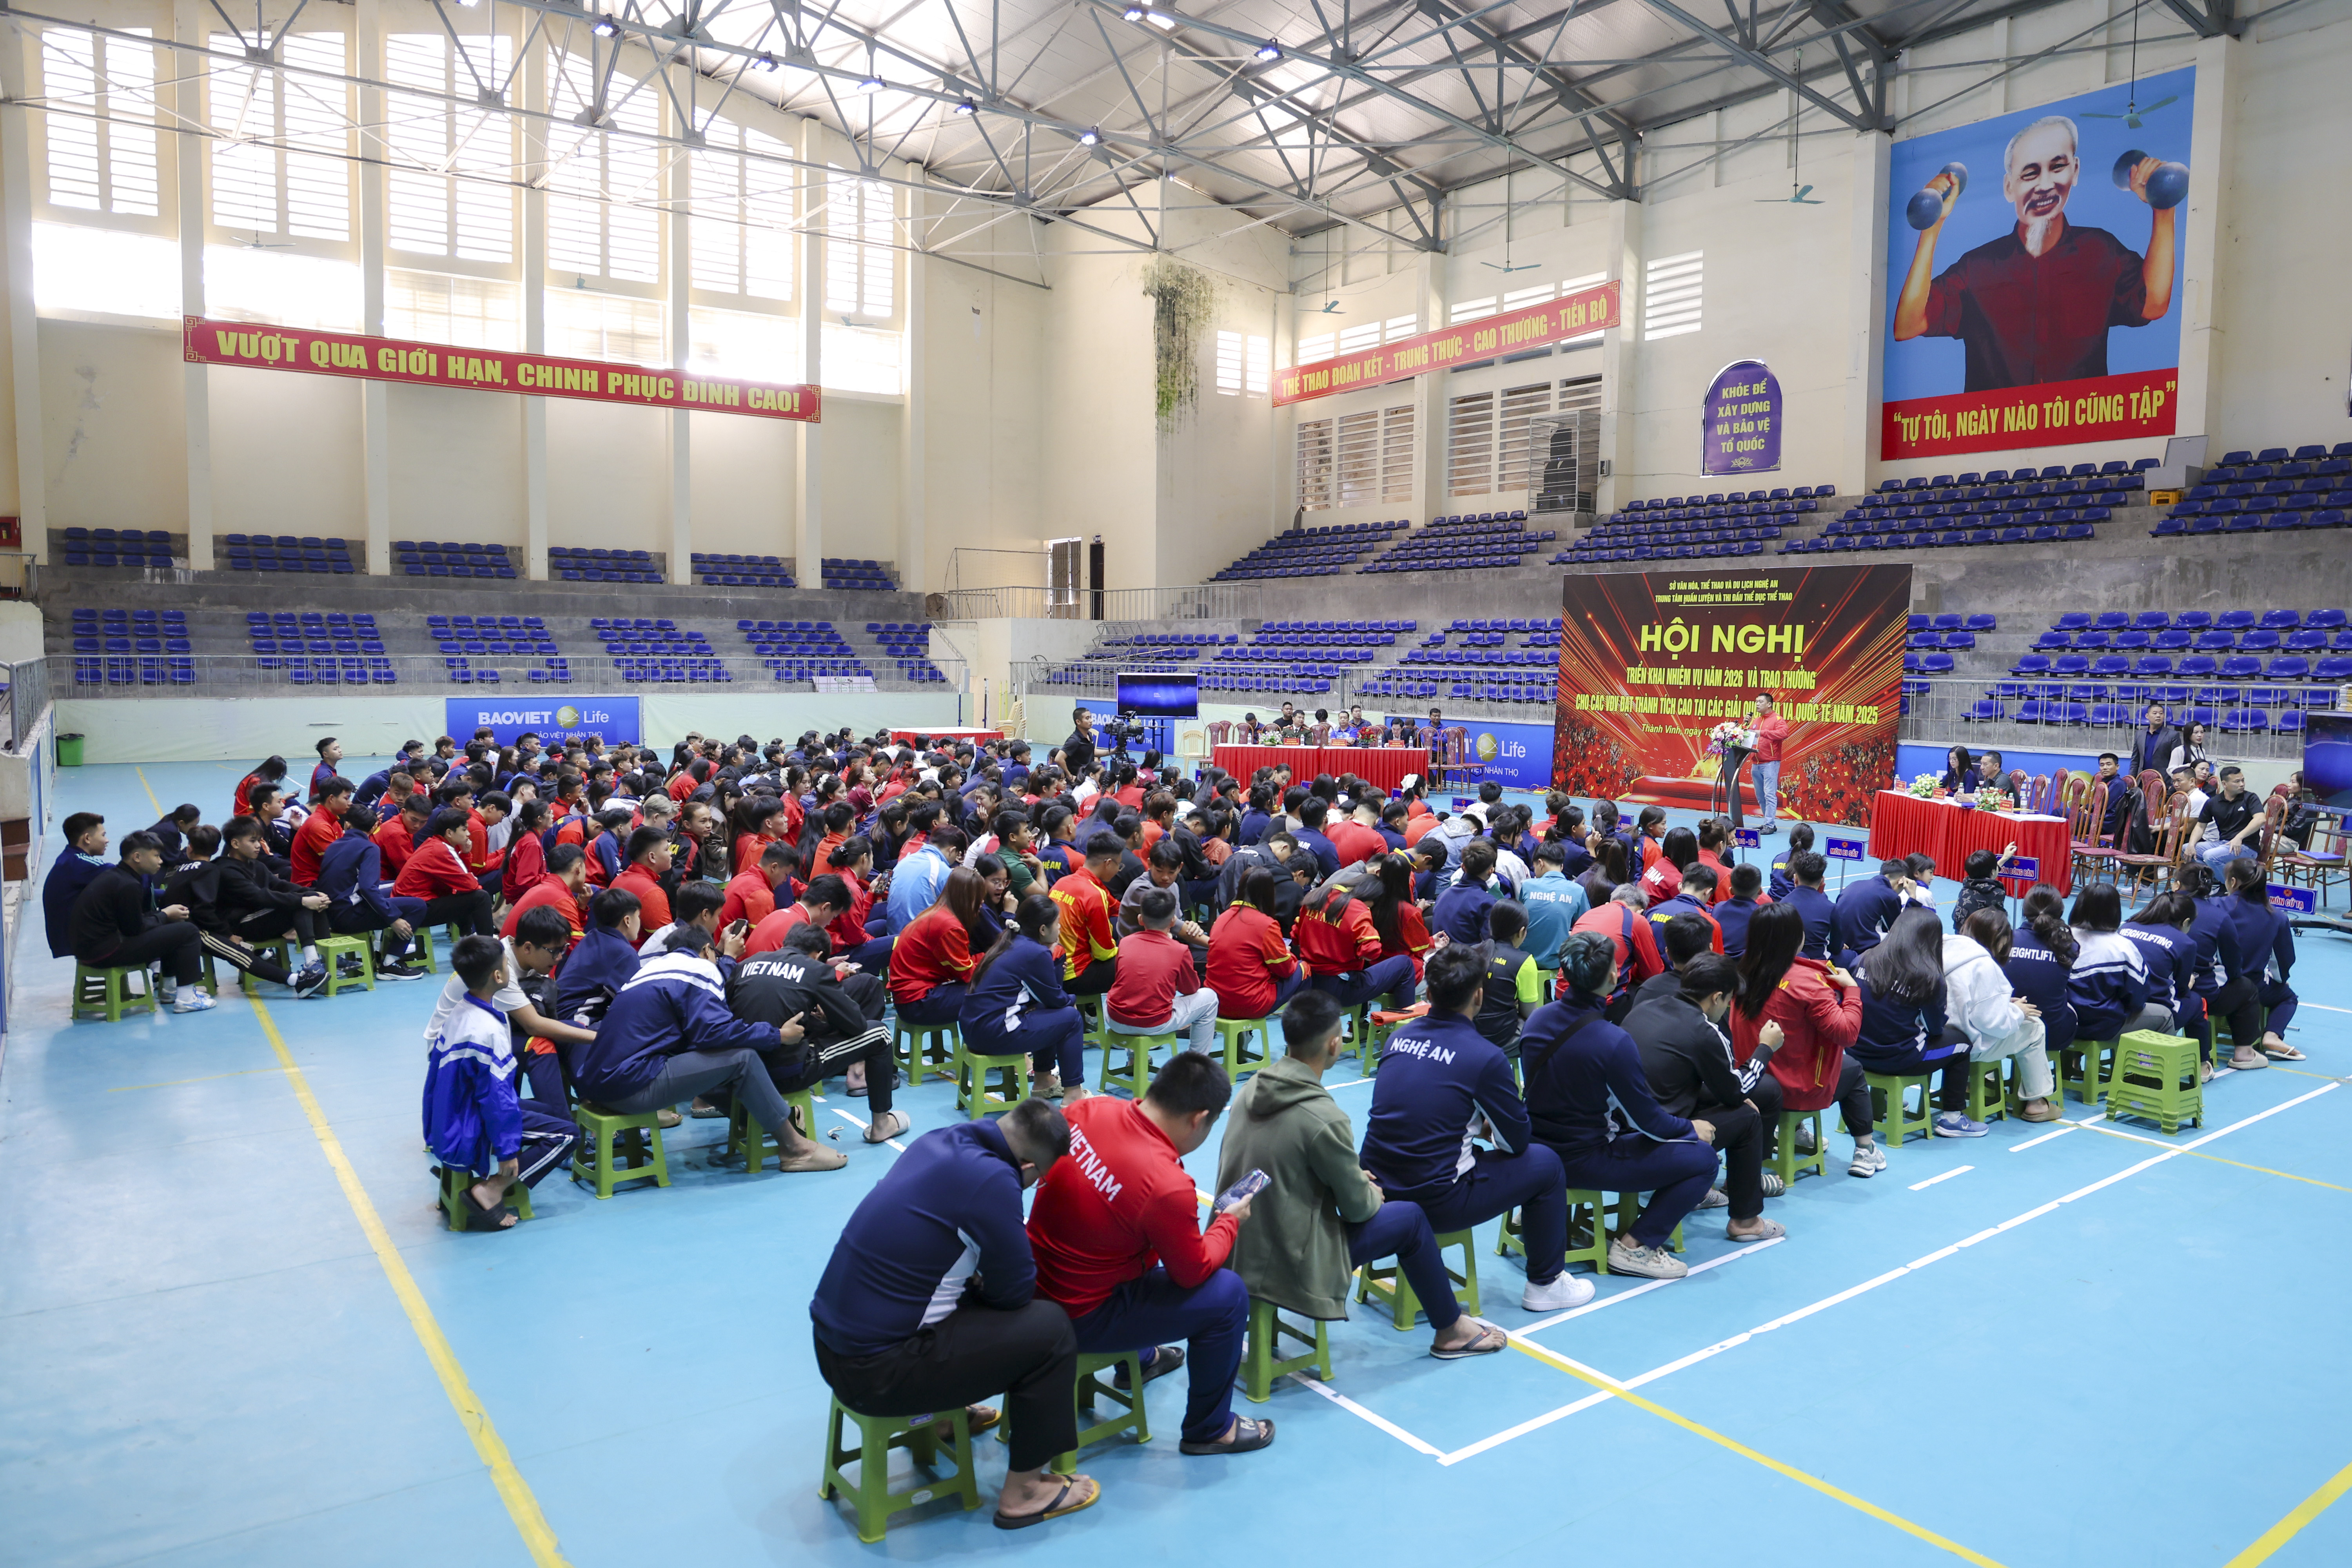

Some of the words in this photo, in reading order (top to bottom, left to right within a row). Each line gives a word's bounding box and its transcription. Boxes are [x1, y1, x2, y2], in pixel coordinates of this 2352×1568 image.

[1282, 368, 1300, 397] THỂ
[1303, 372, 1329, 392] THAO
[1332, 361, 1360, 387] ĐOÀN
[1363, 355, 1383, 379] KẾT
[1394, 345, 1429, 371] TRUNG
[1432, 334, 1463, 363] THỰC
[1474, 332, 1497, 353] CAO
[1501, 318, 1548, 345] THƯỢNG
[1560, 302, 1586, 332] TIẾN
[1590, 293, 1608, 325] BỘ
[216, 330, 299, 365] VƯỢT
[310, 340, 368, 369] QUA
[377, 348, 437, 377] GIỚI
[447, 356, 509, 386] HẠN,
[517, 363, 598, 393] CHINH
[608, 372, 674, 401] PHỤC
[682, 378, 740, 407] ĐỈNH
[747, 387, 800, 413] CAO!
[1722, 382, 1749, 399] KHỎE
[1752, 377, 1767, 394] ĐỂ
[1717, 404, 1738, 418] XÂY
[1741, 400, 1770, 416] DỰNG
[1924, 409, 1951, 441] TÔI,
[1956, 405, 1999, 437] NGÀY
[2004, 400, 2038, 432] NÀO
[2043, 397, 2069, 427] TÔI
[2075, 392, 2123, 425] CŨNG
[1717, 421, 1730, 436] VÀ
[1733, 418, 1754, 434] BẢO
[1757, 417, 1770, 433] VỆ
[1721, 437, 1734, 453] TỔ
[1737, 435, 1765, 452] QUỐC
[1669, 580, 1677, 590] SỞ
[1677, 581, 1687, 590] VĂN
[1688, 580, 1700, 591] HÓA,
[1700, 579, 1711, 590] THỂ
[1711, 581, 1724, 589] THAO
[1725, 579, 1732, 589] VÀ
[1741, 580, 1753, 590] LỊCH
[1754, 578, 1769, 590] NGHỆ
[1770, 579, 1779, 588] AN
[1672, 593, 1683, 602] TÂM
[1698, 593, 1714, 603] LUYỆN
[1715, 592, 1722, 602] VÀ
[1723, 593, 1731, 602] THI
[1732, 591, 1743, 601] ĐẤU
[1744, 590, 1755, 602] THỂ
[1755, 592, 1766, 603] DỤC
[1767, 590, 1778, 601] THỂ
[1779, 592, 1793, 601] THAO
[1640, 617, 1699, 660] HỘI
[1711, 624, 1804, 662] NGHỊ
[1626, 661, 1647, 685] TRIỂN
[1648, 667, 1666, 685] KHAI
[1666, 664, 1691, 689] NHIỆM
[1693, 670, 1703, 690] VỤ
[1704, 666, 1722, 688] NĂM
[1724, 670, 1744, 688] 2026
[1747, 666, 1759, 688] VÀ
[1759, 671, 1781, 689] TRAO
[1782, 665, 1816, 690] THƯỞNG
[1576, 694, 1590, 710] CHO
[1590, 691, 1604, 711] CÁC
[1606, 695, 1619, 711] VĐV
[1620, 696, 1633, 716] ĐẠT
[1635, 693, 1659, 713] THÀNH
[1660, 694, 1675, 715] TÍCH
[1678, 698, 1692, 716] CAO
[1694, 699, 1706, 720] TẠI
[1707, 696, 1723, 717] CÁC
[1725, 695, 1742, 719] GIẢI
[1783, 698, 1793, 720] VÀ
[1795, 697, 1818, 723] QUỐC
[1821, 698, 1831, 722] TẾ
[1833, 702, 1854, 724] NĂM
[1855, 705, 1879, 724] 2025
[478, 711, 552, 724] BAOVIET
[584, 711, 609, 723] Life
[1641, 724, 1663, 733] Thành
[1664, 725, 1682, 735] Vinh,
[1684, 728, 1702, 737] ngày
[1502, 741, 1526, 758] Life
[1485, 766, 1503, 775] NHÂN
[1504, 768, 1519, 777] THỌ
[1848, 849, 1858, 857] SẮT
[1050, 861, 1062, 869] AN
[2009, 867, 2023, 876] BÓNG
[2024, 868, 2034, 877] BÀN
[1062, 894, 1075, 906] AN
[1530, 891, 1555, 903] NGHỆ
[1559, 894, 1572, 903] AN
[2269, 896, 2285, 906] MÔN
[2285, 898, 2295, 907] CỬ
[2296, 900, 2304, 910] TẠ
[741, 961, 806, 983] VIETNAM
[1390, 1037, 1430, 1060] NGHỆ
[1430, 1048, 1455, 1065] AN
